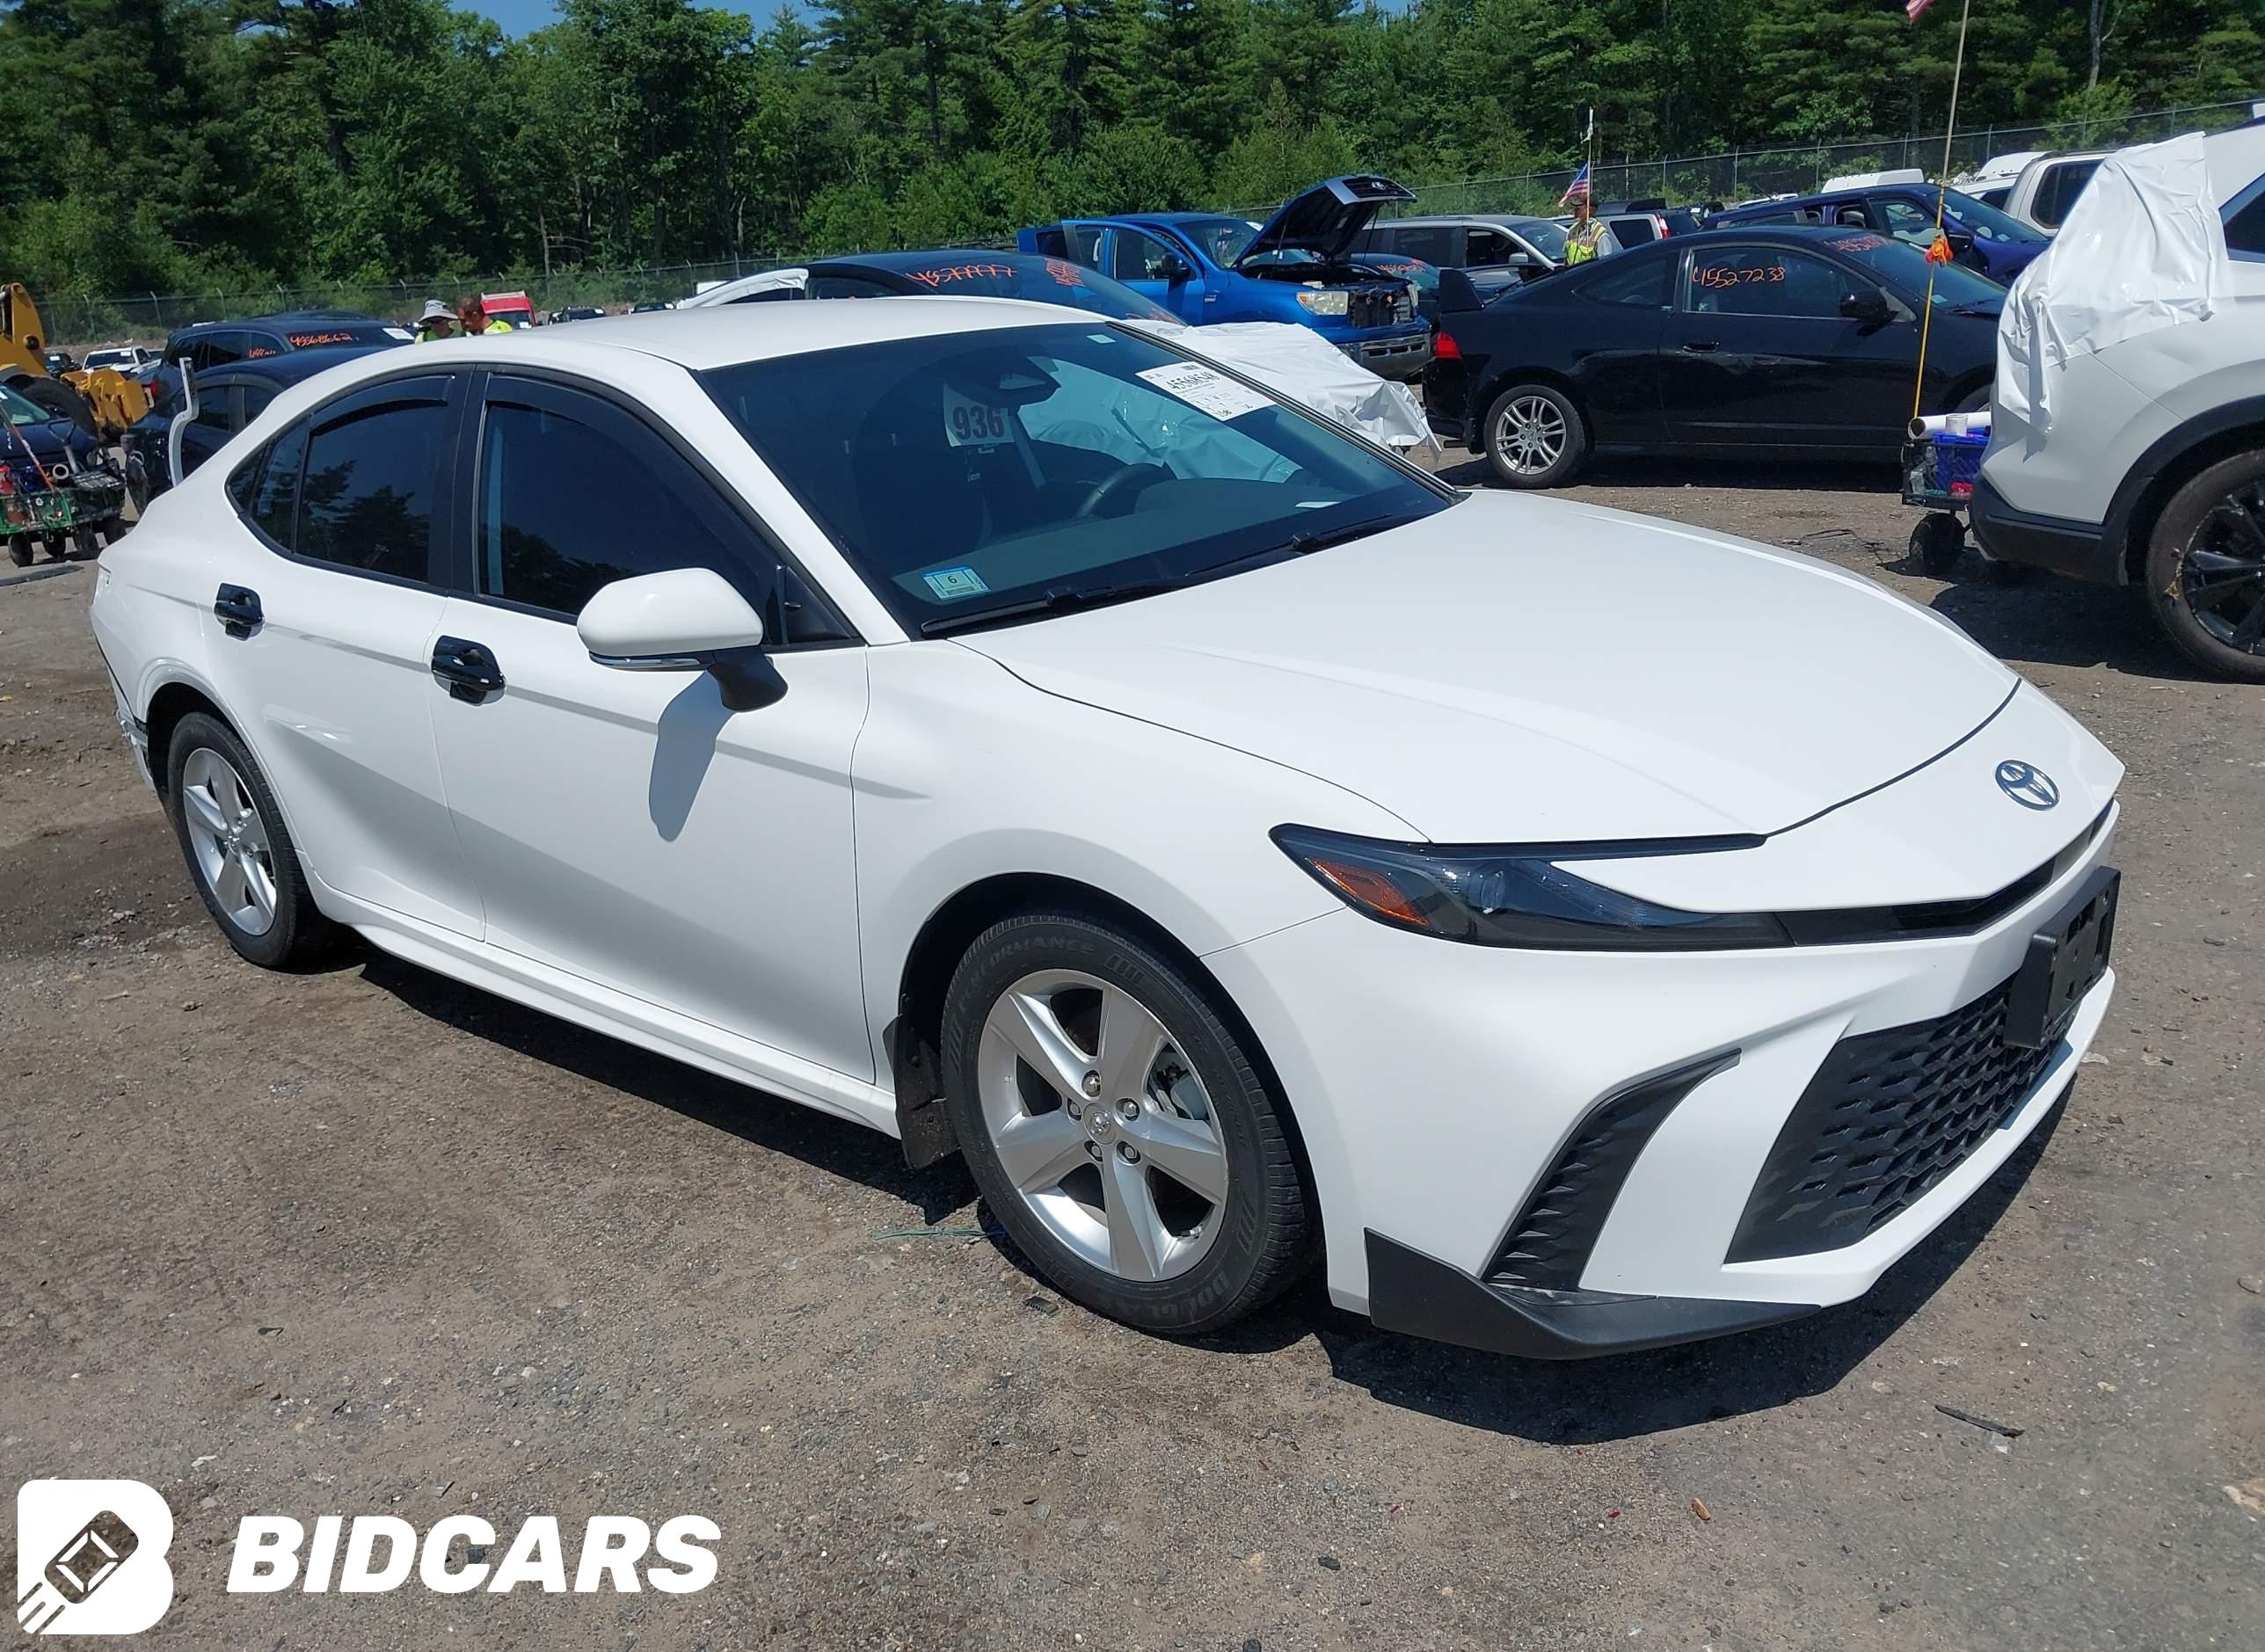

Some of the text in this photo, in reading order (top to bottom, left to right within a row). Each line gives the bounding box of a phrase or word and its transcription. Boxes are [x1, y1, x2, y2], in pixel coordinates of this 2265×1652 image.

[1692, 266, 1786, 288] 45527238
[952, 405, 1005, 440] 936
[947, 575, 958, 584] 6
